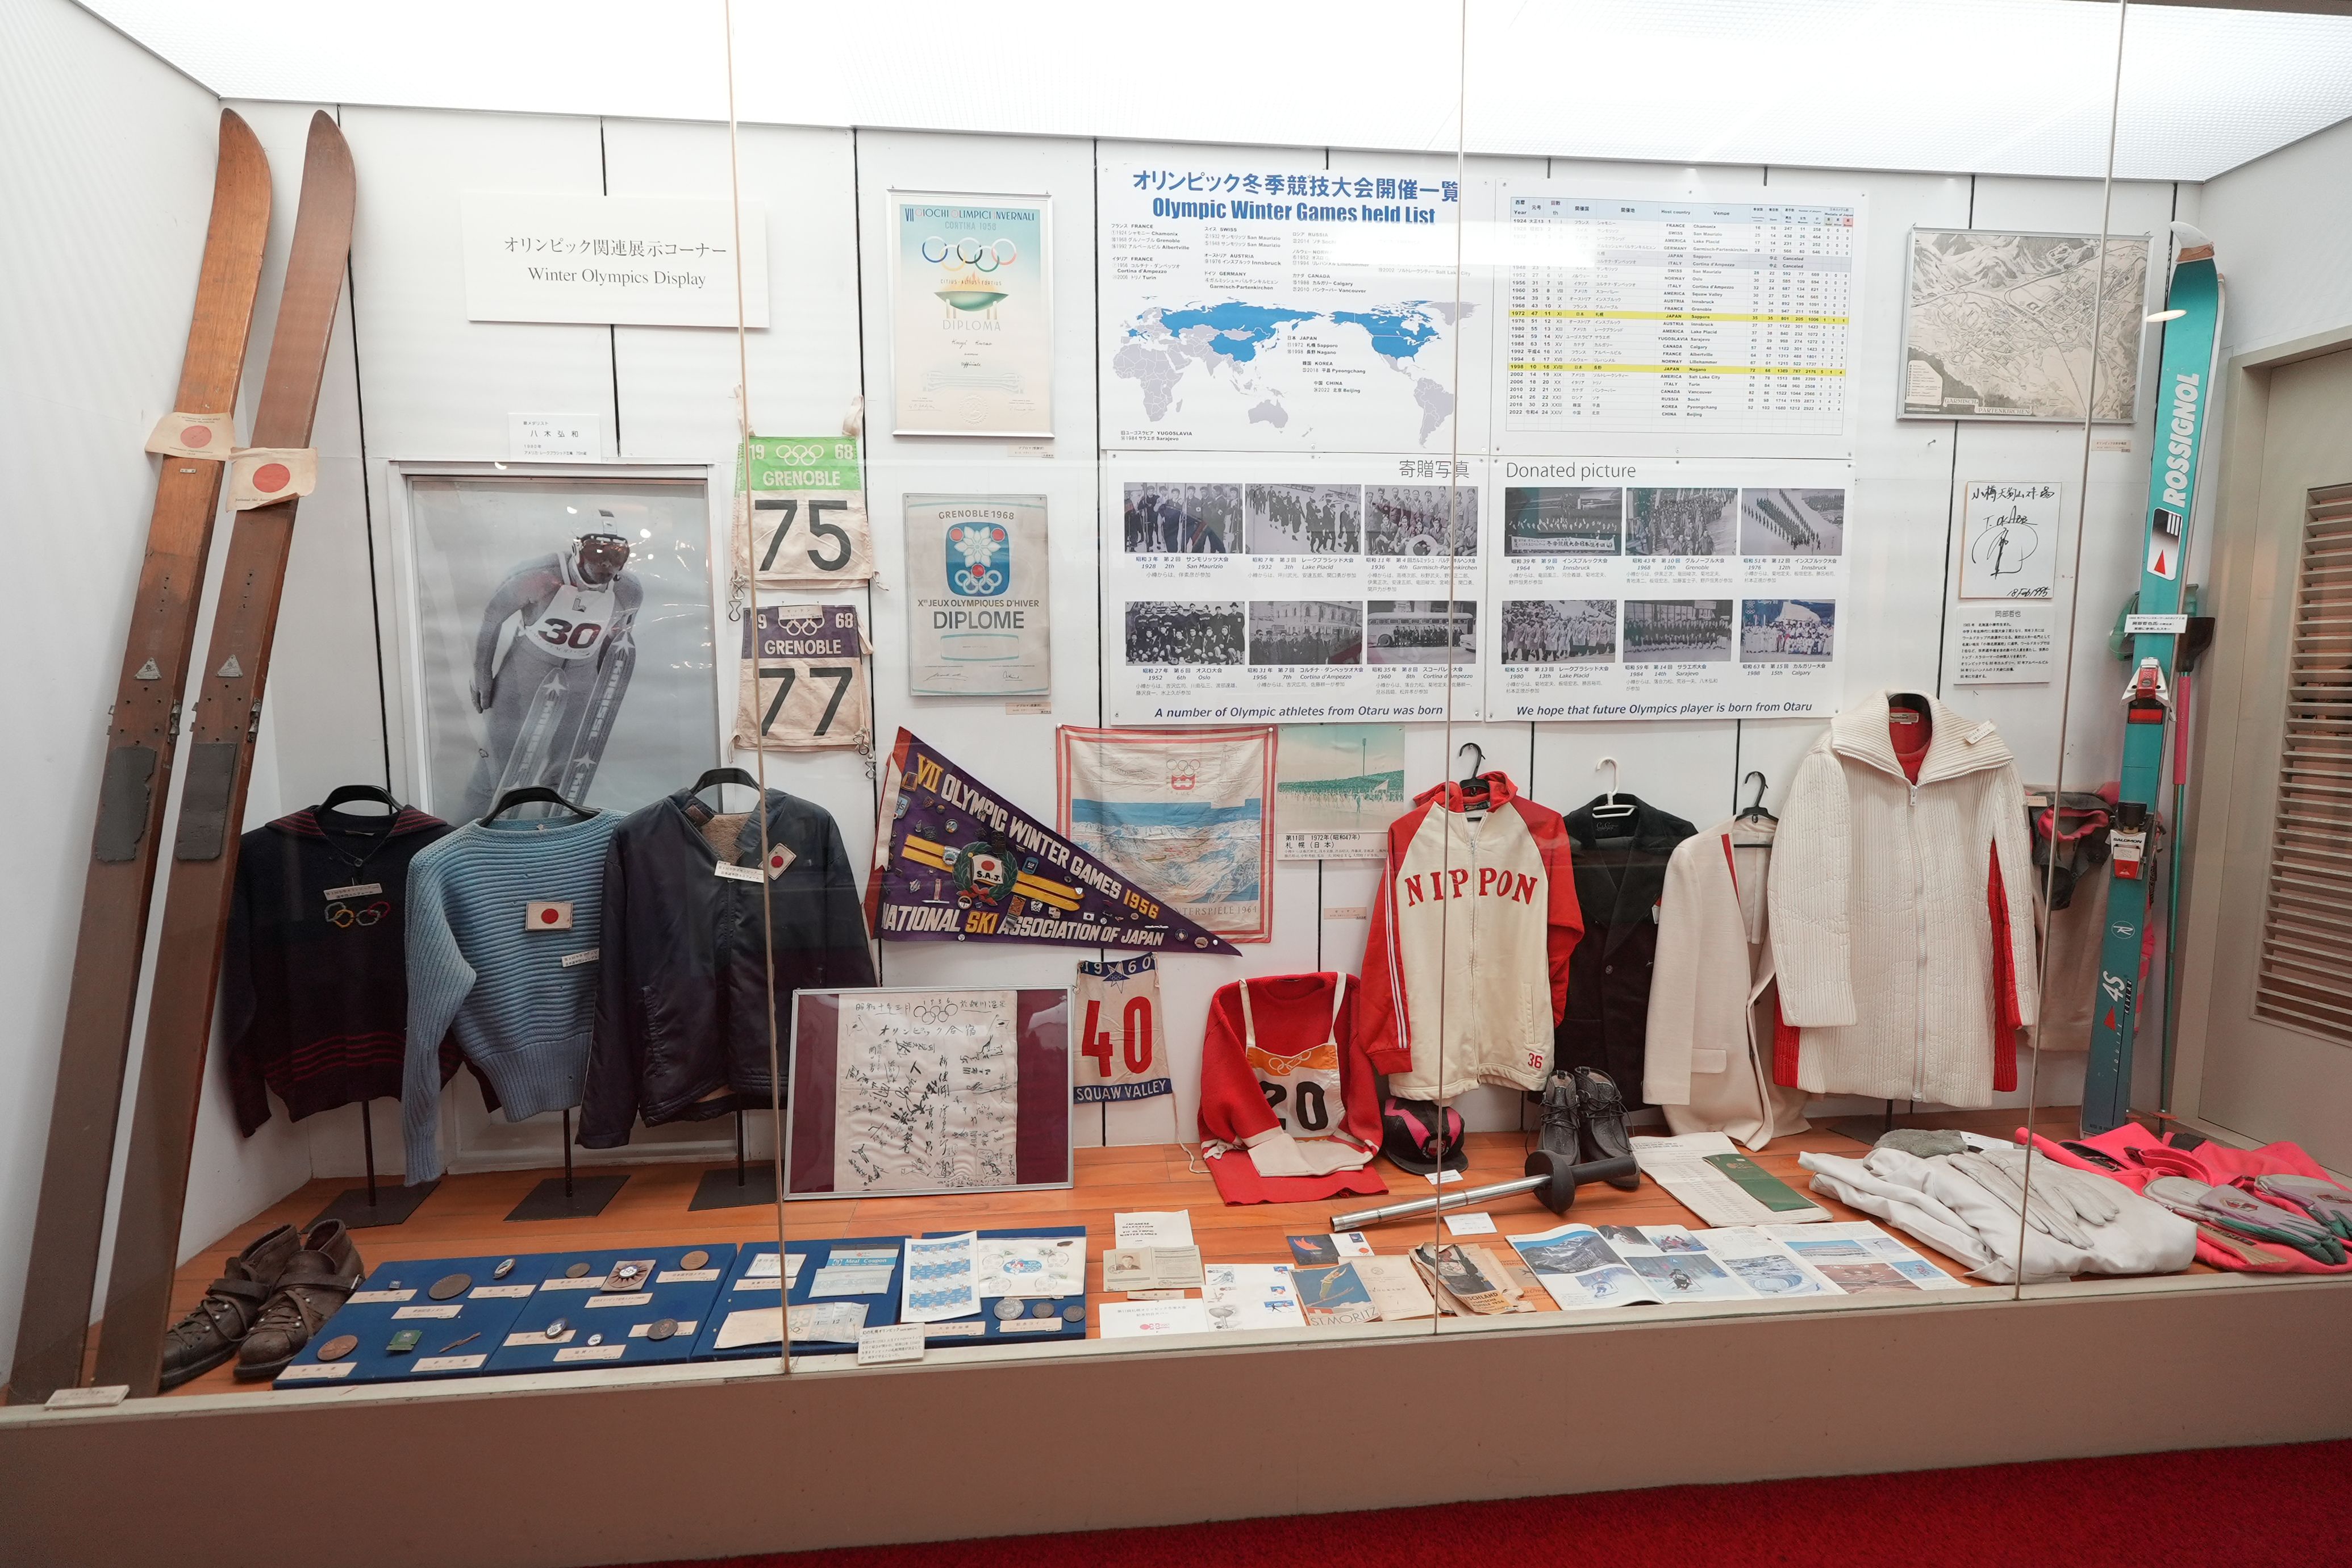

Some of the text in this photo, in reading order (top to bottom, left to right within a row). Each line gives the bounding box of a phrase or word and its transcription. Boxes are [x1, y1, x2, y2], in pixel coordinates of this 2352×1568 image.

[1133, 170, 1459, 203] オリンピック冬季競技大会開催一覧
[905, 208, 1035, 222] VII GIOCHI OLIMPICI INVERNALI
[1153, 197, 1435, 225] Olympic Winter Games held List
[945, 221, 975, 230] CORTINA
[504, 237, 727, 258] オリンピック関連展示コーナー
[528, 267, 706, 289] Winter Olympics Display
[943, 319, 1001, 331] DIPLOMA
[2163, 373, 2200, 508] ROSSIGNOL
[835, 444, 853, 460] 68
[763, 470, 840, 486] GRENOBLE
[1399, 460, 1470, 479] 寄贈写真
[1506, 461, 1637, 482] Donated picture
[939, 510, 1015, 520] GRENOBLE 1968
[755, 499, 852, 572] 75
[950, 599, 1004, 608] OLYMPIQUES
[836, 612, 853, 628] 68
[933, 610, 1024, 629] DIPLOME
[538, 618, 602, 649] 30
[764, 639, 841, 655] GRENOBLE
[758, 667, 853, 737] 77
[1516, 702, 1812, 718] We hope that future Olympics player is born from Otaru
[1154, 706, 1442, 719] A number of Olympic athletes from Otaru was born
[917, 753, 1160, 920] VII OLYMPIC WINTER GAMES 1956
[1405, 867, 1538, 907] NIPPON
[881, 902, 1165, 947] NATIONAL SKI ASSOCIATION OF JAPAN
[1082, 995, 1153, 1078] 40
[1527, 1053, 1543, 1069] 36
[1077, 1080, 1166, 1101] SQUAW VALLEY
